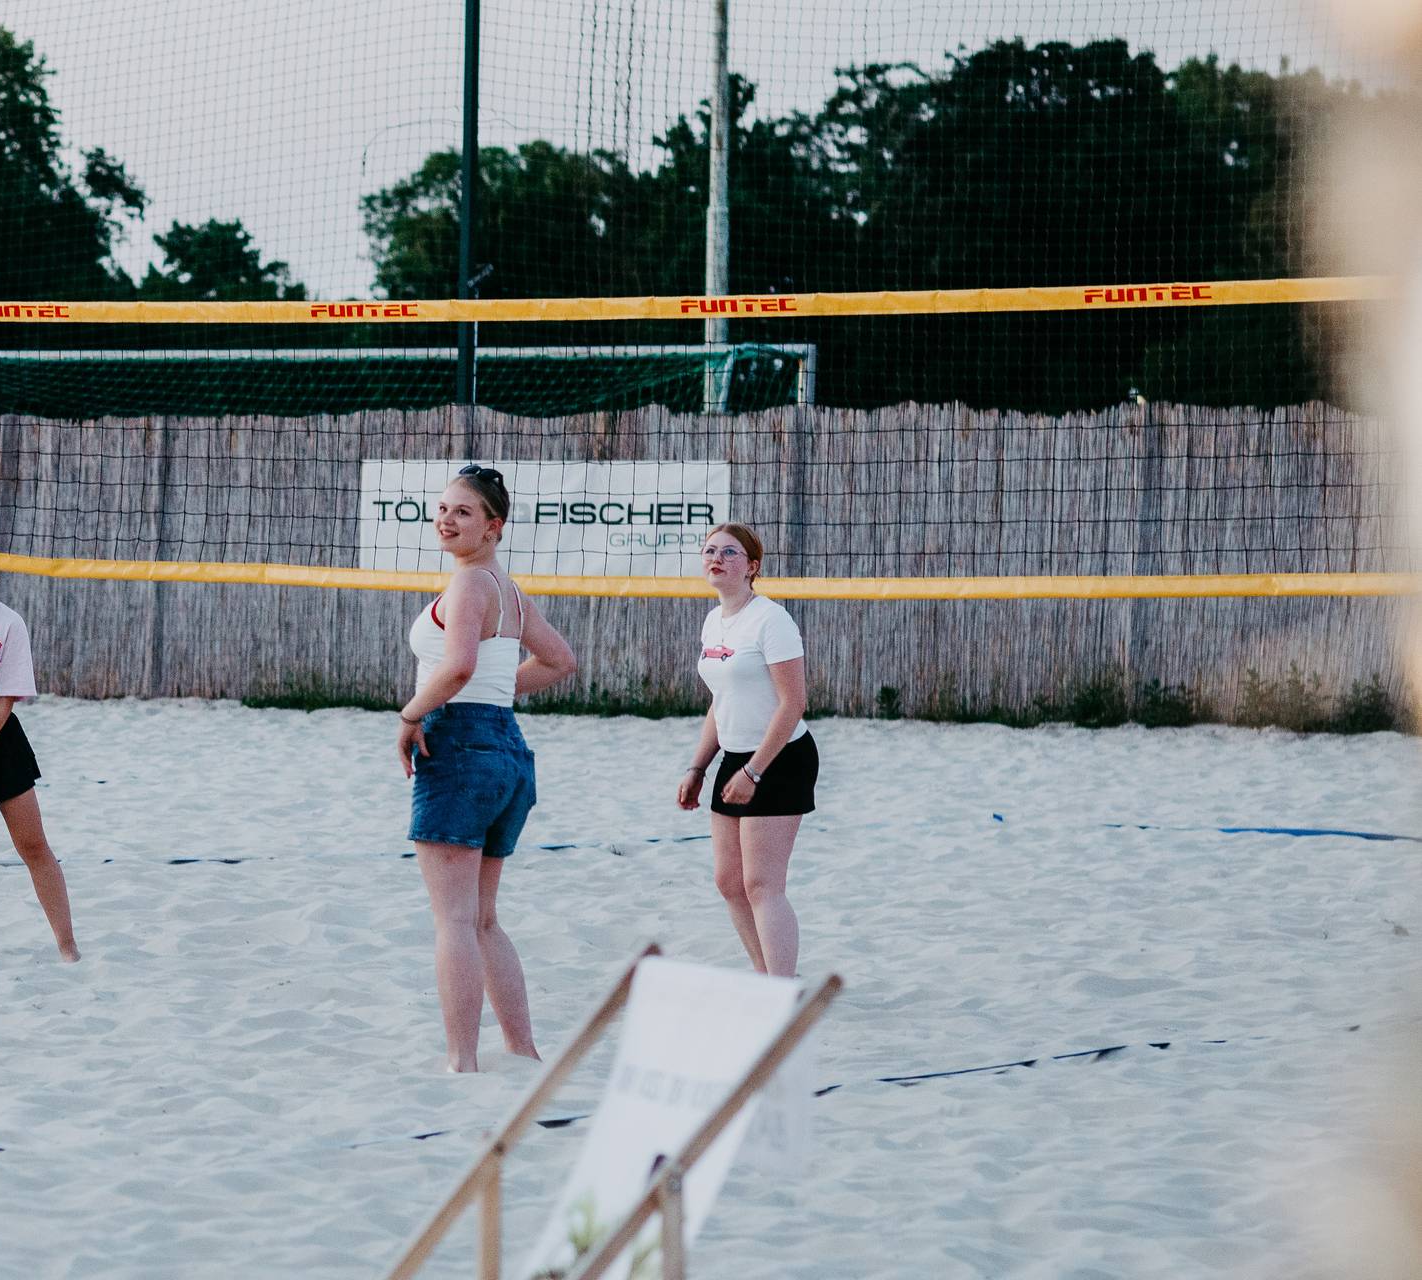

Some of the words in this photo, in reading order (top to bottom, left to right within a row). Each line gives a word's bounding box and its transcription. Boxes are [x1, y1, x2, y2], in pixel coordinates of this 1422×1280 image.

[1084, 285, 1212, 304] FUNTEC
[311, 303, 419, 318] FUNTEC
[680, 298, 797, 313] FUNTEC
[373, 496, 434, 523] TÖL
[535, 502, 715, 525] FISCHER
